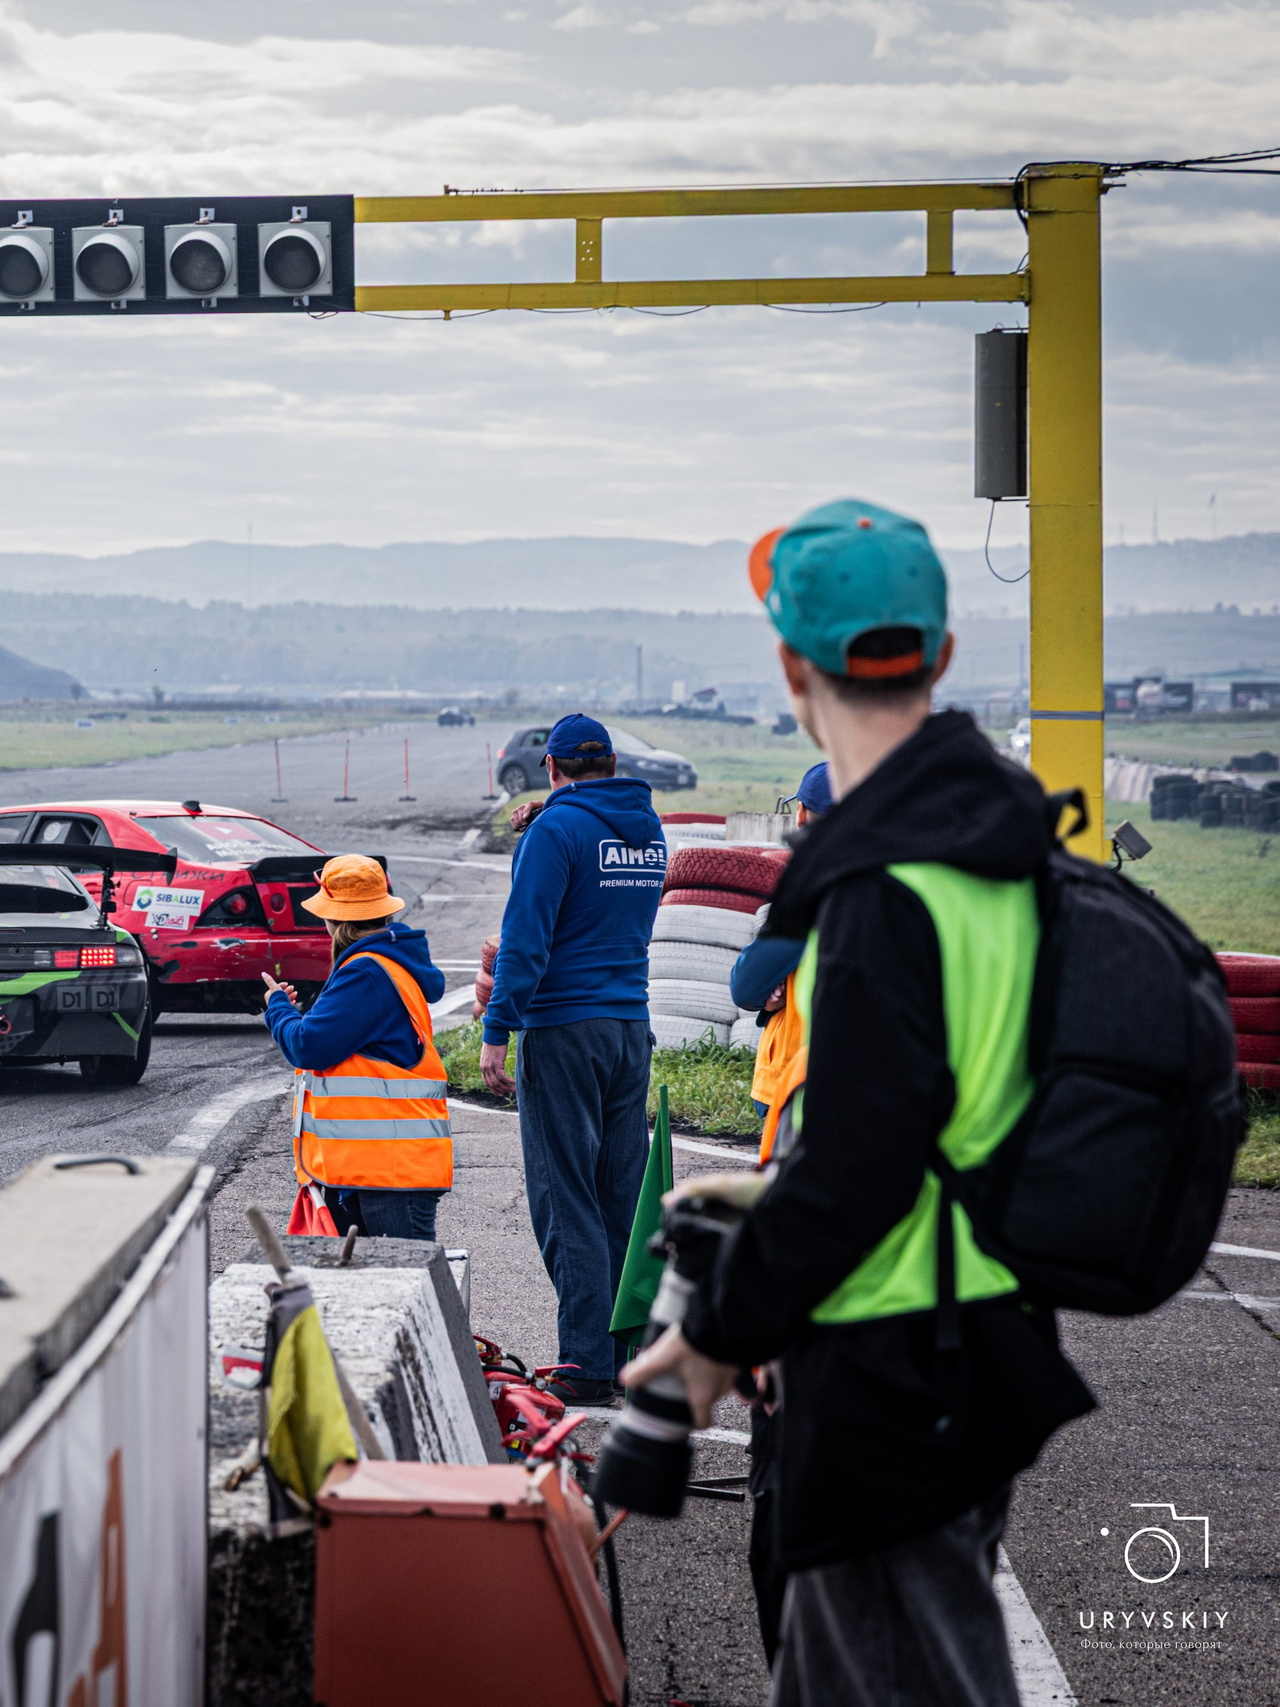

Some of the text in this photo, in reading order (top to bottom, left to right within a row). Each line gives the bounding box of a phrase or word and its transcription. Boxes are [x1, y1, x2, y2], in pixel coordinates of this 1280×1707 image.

[604, 847, 666, 866] AIMOL
[156, 893, 200, 905] SIBALUX
[63, 991, 115, 1007] D1 D1
